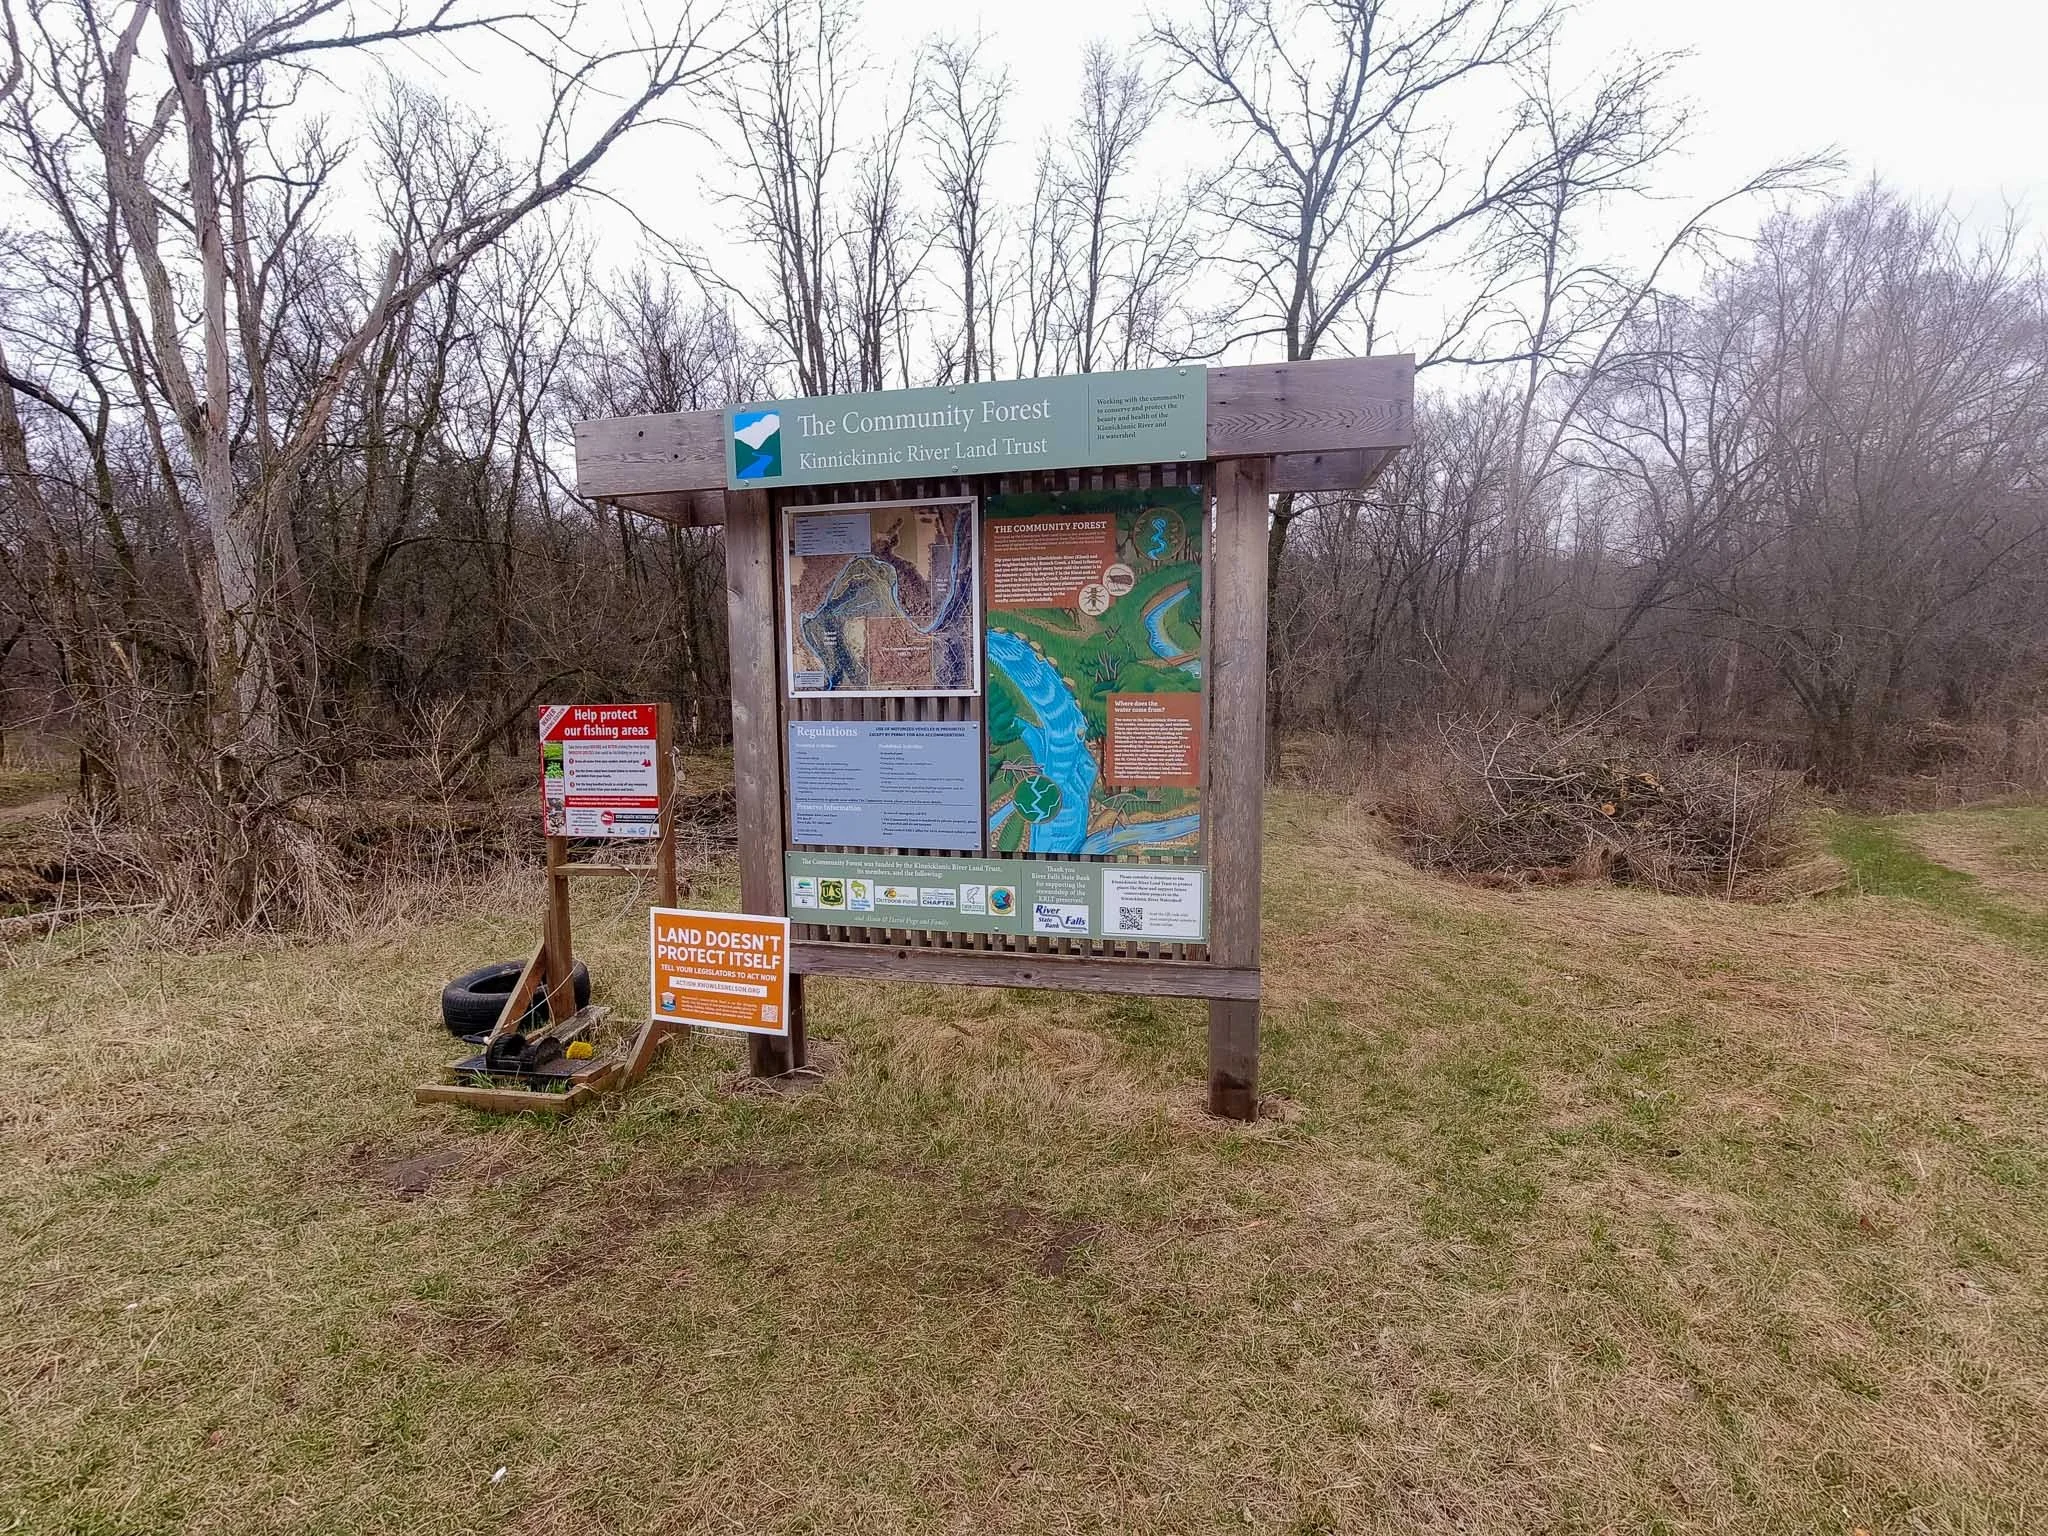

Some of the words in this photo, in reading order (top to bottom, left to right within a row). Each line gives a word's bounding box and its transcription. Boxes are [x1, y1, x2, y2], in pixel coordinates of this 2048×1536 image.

[1124, 395, 1138, 403] with
[1144, 404, 1167, 412] protect
[797, 413, 836, 437] The
[842, 404, 975, 433] Community
[981, 399, 1051, 423] Forest
[1154, 420, 1167, 428] and
[799, 447, 903, 470] Kinnickinnic
[907, 444, 950, 461] River
[955, 438, 997, 459] Land
[1002, 437, 1048, 456] Trust
[994, 525, 1012, 533] THE
[1014, 522, 1071, 532] COMMUNITY
[1073, 521, 1106, 530] FOREST
[541, 708, 557, 726] WADER
[574, 708, 598, 723] Help
[600, 708, 638, 723] protect
[564, 727, 580, 736] our
[583, 724, 618, 738] fishing
[622, 726, 649, 736] areas
[797, 726, 858, 740] Regulations
[823, 804, 862, 812] Information
[1036, 904, 1061, 914] River
[1065, 916, 1086, 926] Falls
[657, 926, 702, 945] LAND
[706, 930, 782, 952] DOESN'T
[658, 944, 726, 966] PROTECT
[729, 951, 782, 970] ITSELF
[661, 964, 674, 972] TELL
[676, 966, 694, 974] YOUR
[694, 967, 736, 978] LEGISLATORS
